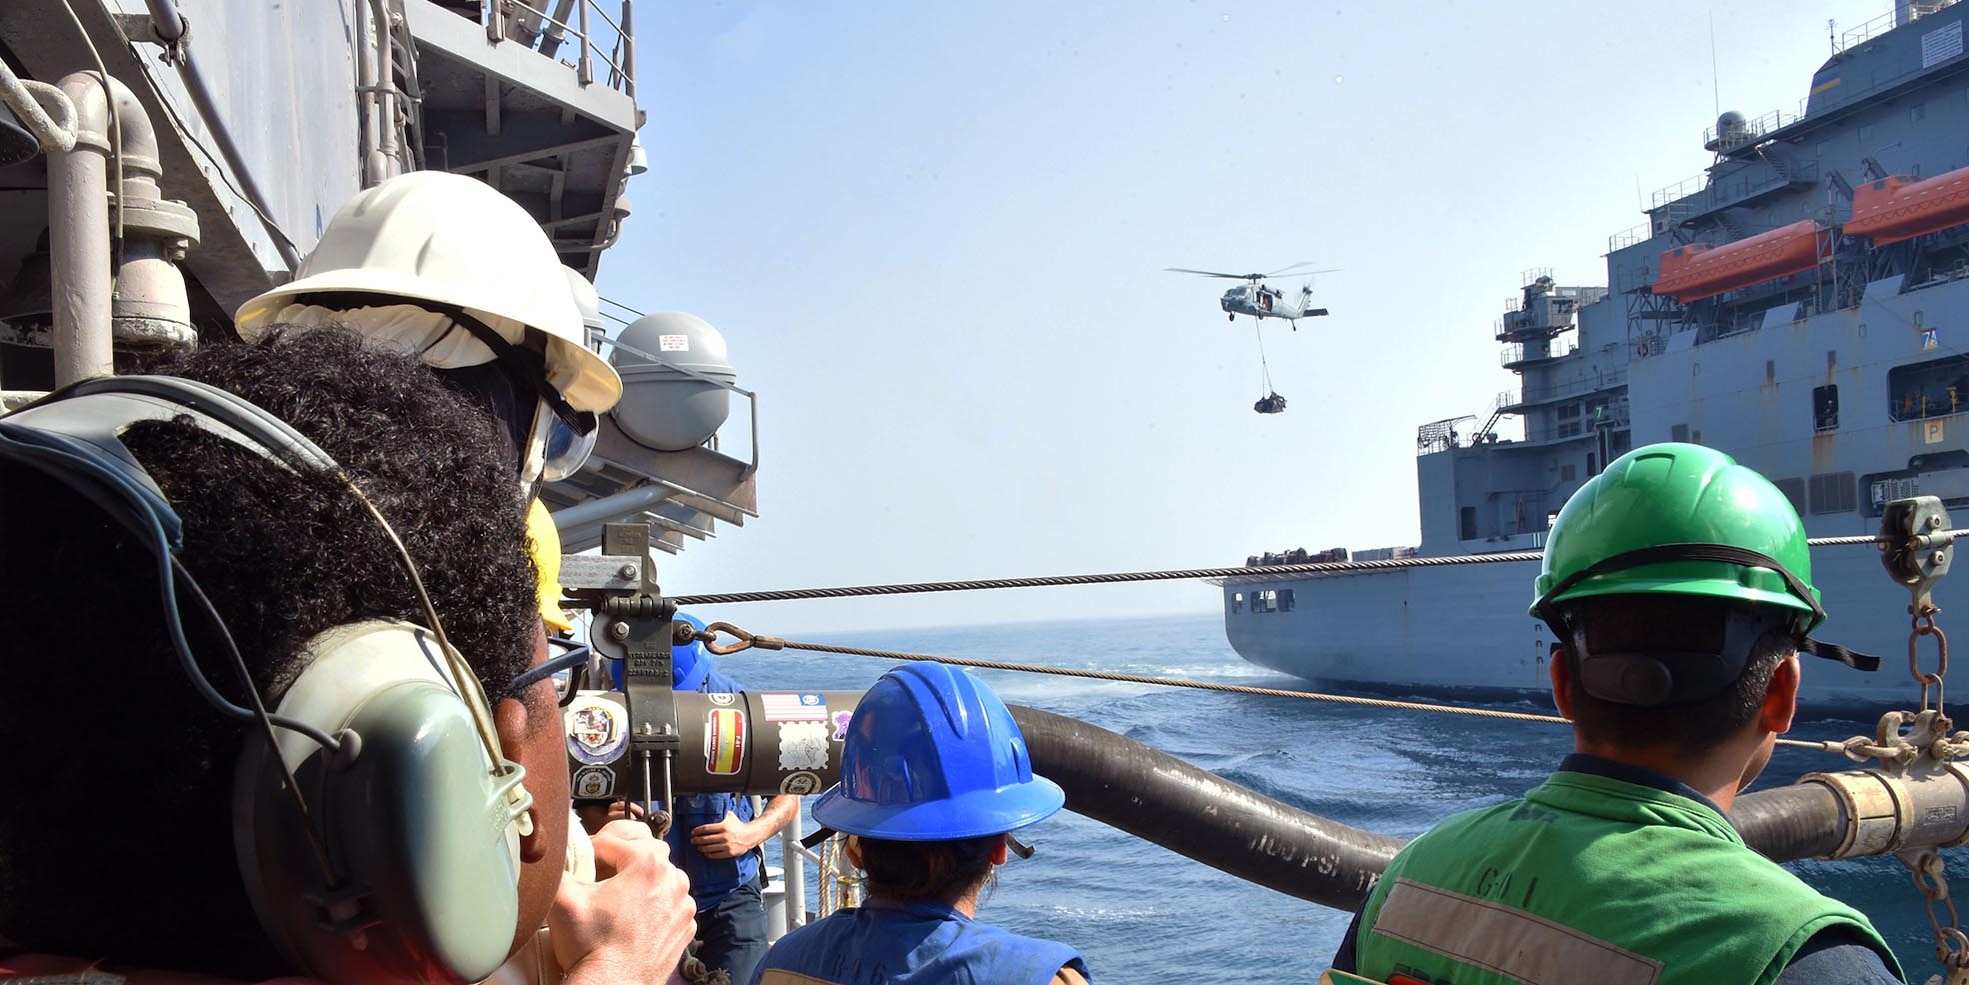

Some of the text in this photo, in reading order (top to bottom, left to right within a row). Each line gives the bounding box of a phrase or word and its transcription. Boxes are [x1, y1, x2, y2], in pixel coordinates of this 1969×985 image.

[1922, 331, 1938, 350] 7A
[1595, 407, 1602, 418] 7
[1930, 425, 1939, 441] P
